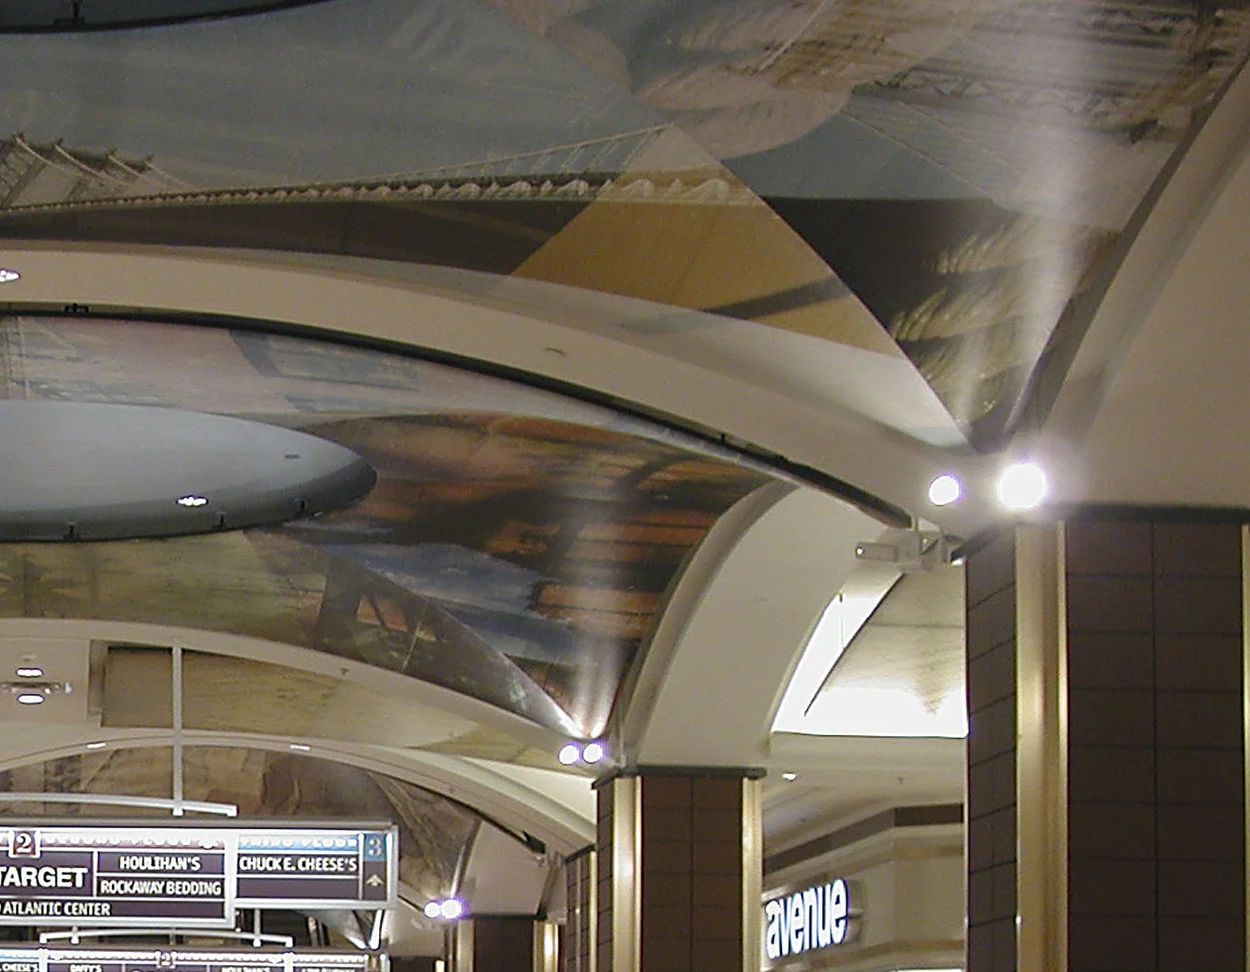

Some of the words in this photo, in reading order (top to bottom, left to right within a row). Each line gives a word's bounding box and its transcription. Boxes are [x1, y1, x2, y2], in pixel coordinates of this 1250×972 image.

[16, 833, 32, 854] 2
[368, 838, 382, 857] 3
[119, 856, 201, 871] HOULIHAN'S
[239, 857, 282, 871] CHUCK
[283, 858, 296, 871] E.
[297, 858, 357, 872] CHEESE'S
[100, 879, 163, 895] ROCKAWAY
[166, 880, 222, 895] BEDDING
[3, 901, 61, 915] ATLANTIC
[63, 902, 111, 916] CENTER
[765, 879, 848, 959] avenue
